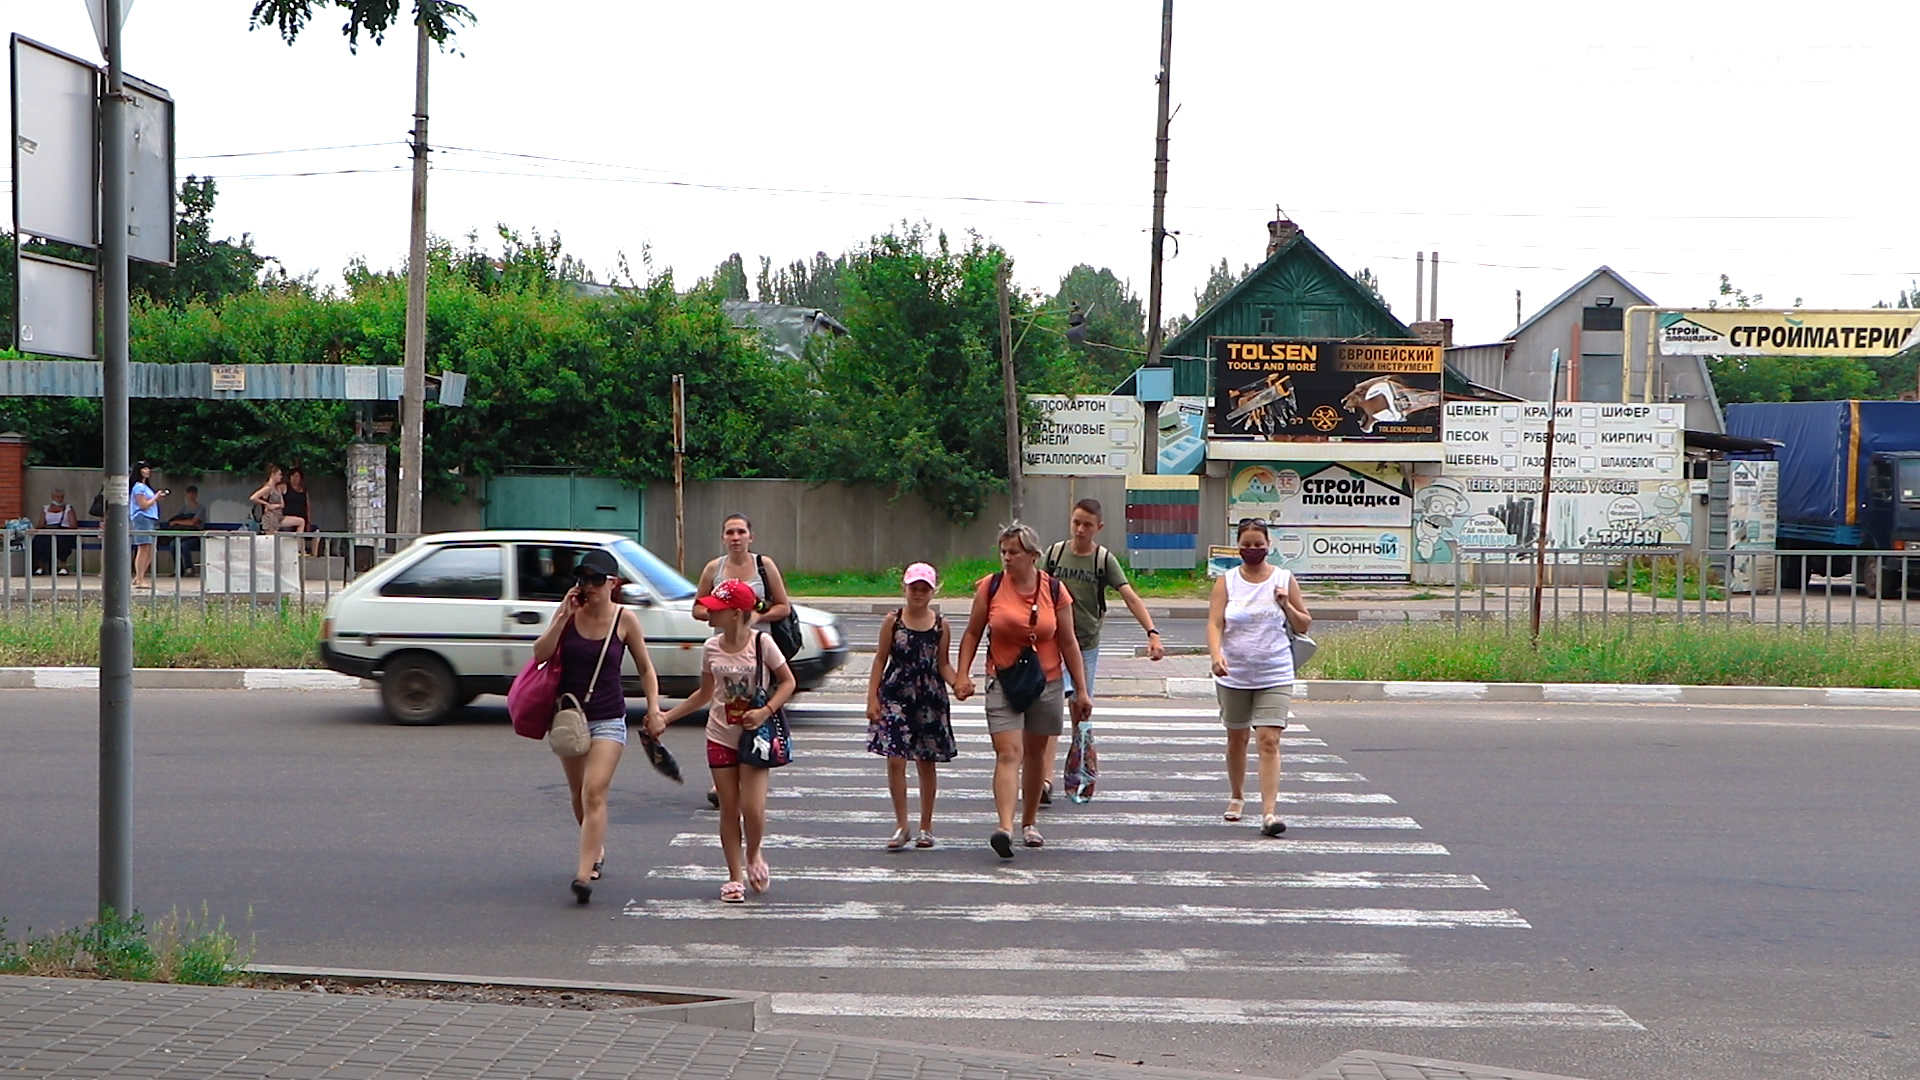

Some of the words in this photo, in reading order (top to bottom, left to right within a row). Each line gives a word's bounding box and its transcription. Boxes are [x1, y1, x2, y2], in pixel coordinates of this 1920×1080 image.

[1227, 343, 1317, 361] TOLSEN
[1339, 347, 1434, 361] ЄВРОПЕЙСКИЙ
[1227, 361, 1260, 370] TOOLS
[1263, 362, 1285, 371] AND
[1287, 362, 1317, 371] MORE
[1377, 363, 1433, 371] ІНСТРУМЕНТ
[1446, 405, 1499, 417] ЦЕМЕНТ
[1524, 407, 1573, 417] КРАКИ
[1602, 407, 1650, 418] ШИФЕР
[1446, 430, 1490, 441] ПЕСОК
[1523, 432, 1577, 445] РУБЕОИД
[1601, 432, 1653, 443] КИРПИЧ
[1445, 454, 1499, 467] ЩЕБЕНЬ
[1522, 456, 1576, 468] ГАЗОЕТОН
[1467, 479, 1500, 493] ТЕПЕРЬ
[1502, 479, 1515, 493] НЕ
[1517, 480, 1544, 494] НАДО
[1610, 519, 1639, 531] ТУТ
[1599, 530, 1660, 545] ТРУБЫ
